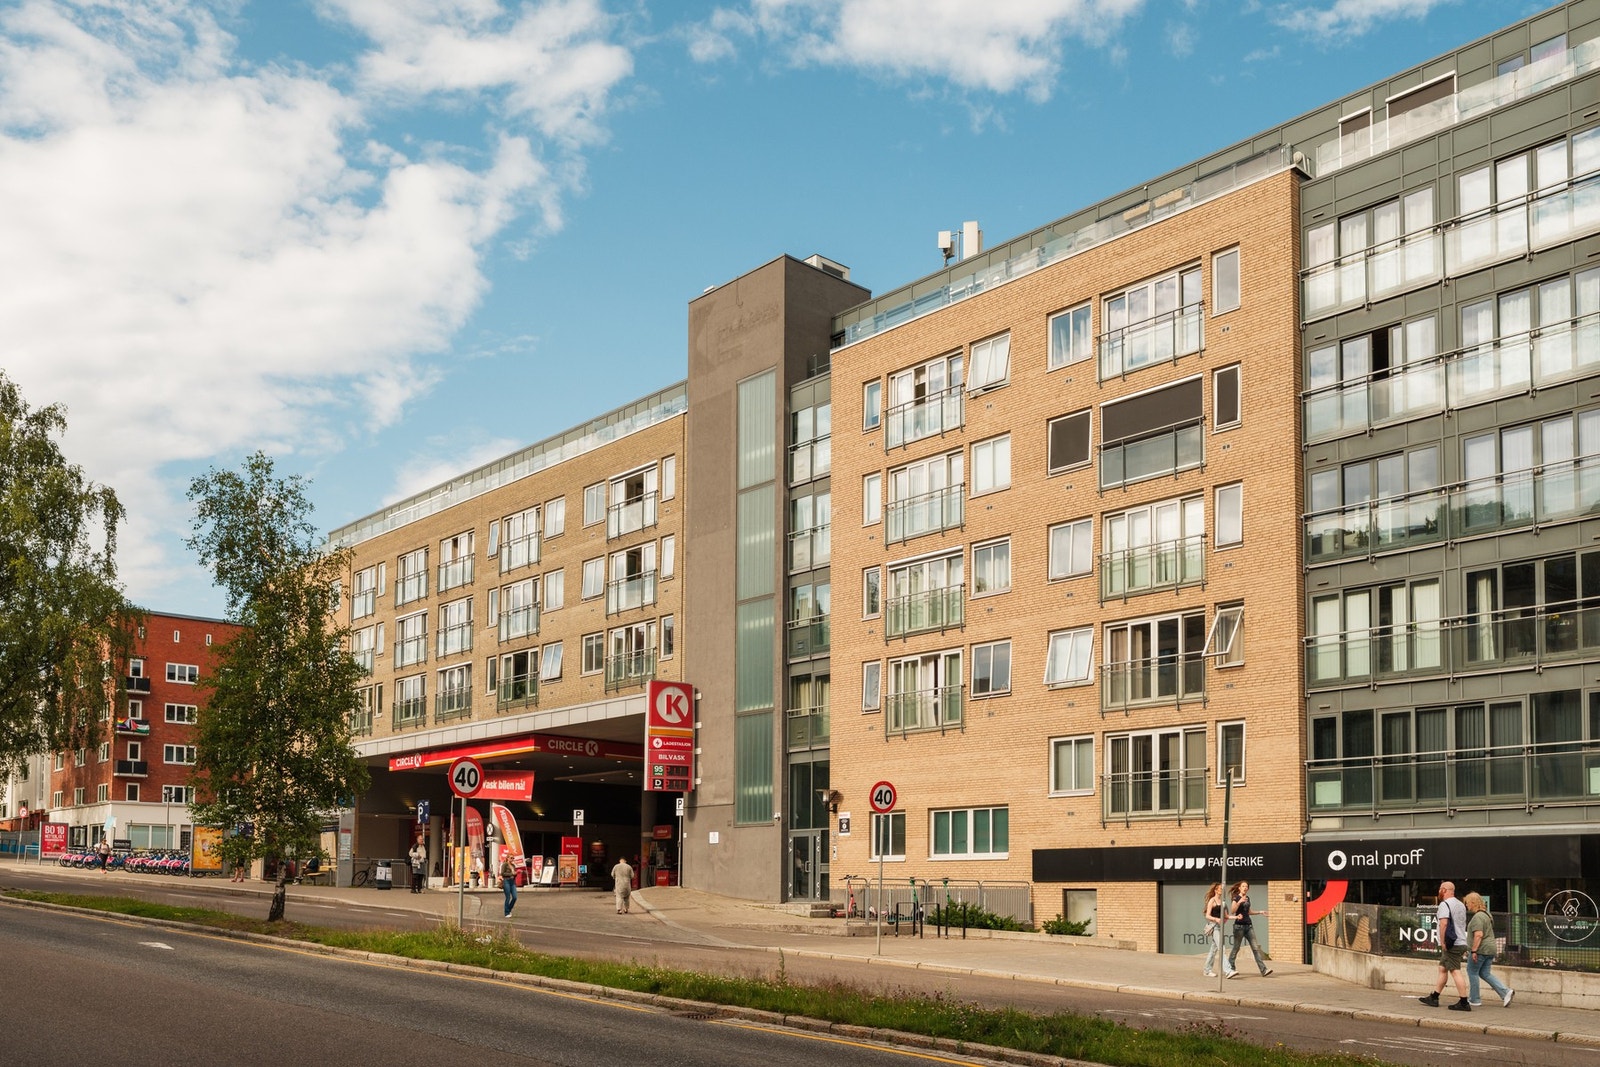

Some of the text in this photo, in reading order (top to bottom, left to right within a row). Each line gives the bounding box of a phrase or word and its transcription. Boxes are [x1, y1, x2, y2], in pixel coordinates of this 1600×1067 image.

[547, 739, 599, 756] CIRCLE K
[396, 756, 413, 767] CIRCLE
[658, 753, 686, 761] BILVASK
[654, 765, 664, 773] 95
[455, 767, 478, 787] 40
[498, 780, 514, 790] bilen
[875, 789, 892, 805] 40
[677, 799, 683, 809] P
[575, 810, 582, 819] P
[1351, 848, 1425, 870] mal proff
